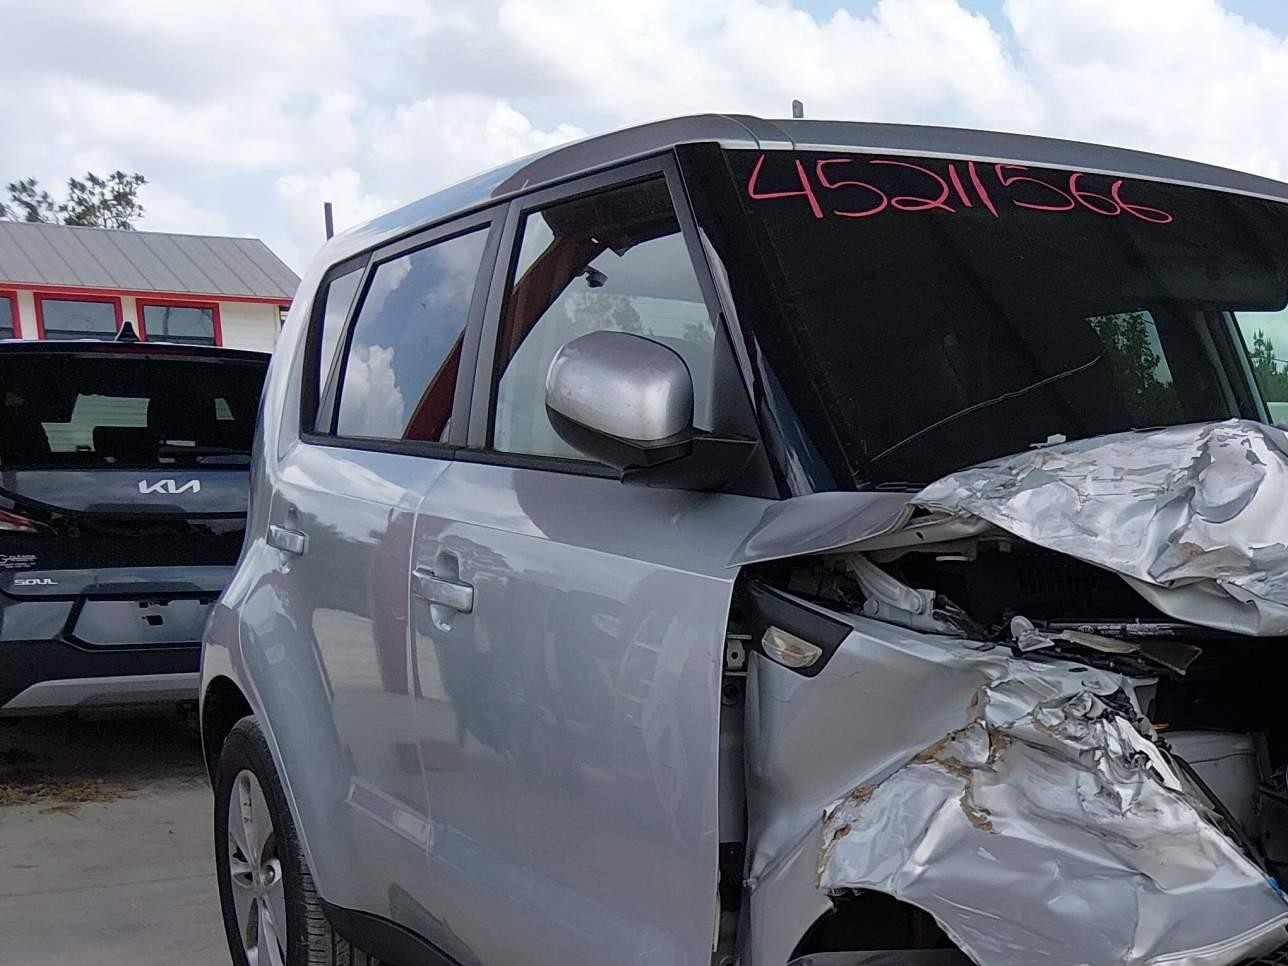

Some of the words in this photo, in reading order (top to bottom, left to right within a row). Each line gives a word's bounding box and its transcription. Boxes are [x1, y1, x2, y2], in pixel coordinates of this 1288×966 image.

[746, 153, 1173, 223] 45211566
[138, 479, 201, 494] KIA
[13, 578, 60, 586] SOUL
